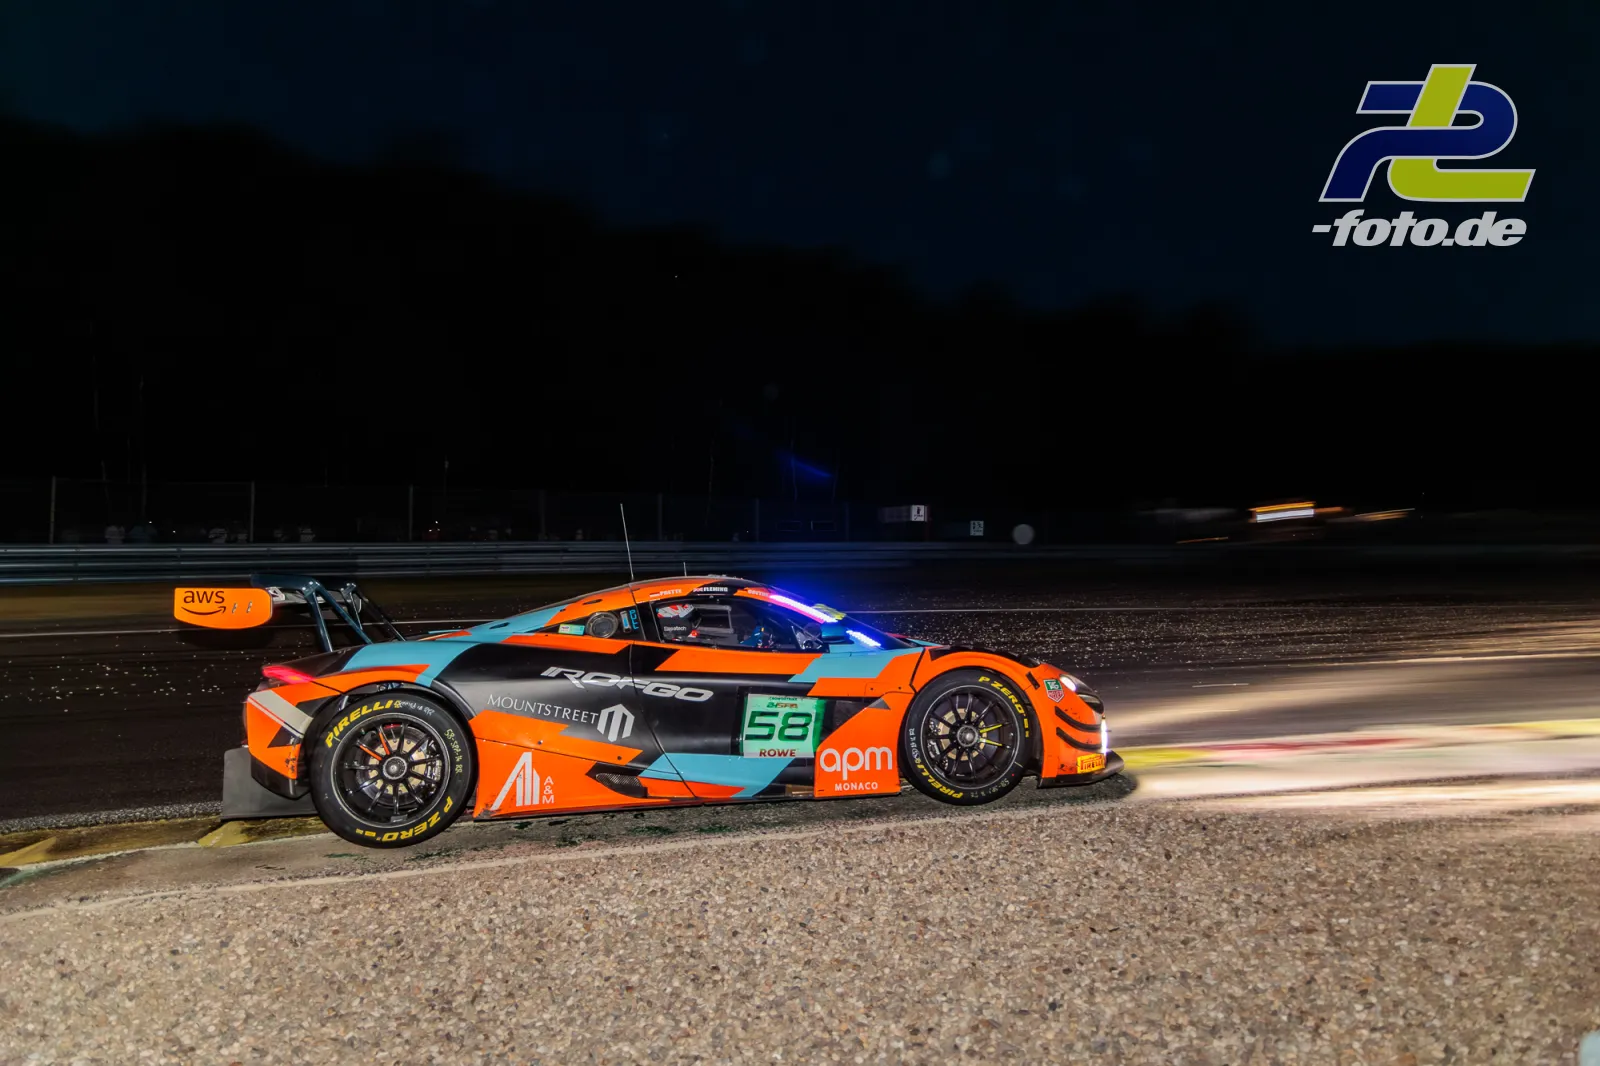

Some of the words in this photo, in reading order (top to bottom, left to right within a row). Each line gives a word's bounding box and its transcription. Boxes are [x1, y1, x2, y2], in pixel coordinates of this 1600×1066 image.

[183, 590, 225, 604] aws
[541, 666, 714, 702] ROFGO
[991, 681, 1025, 714] ZERO
[325, 699, 393, 749] PIRELLI
[487, 694, 599, 725] MOUNTSTREET
[744, 711, 812, 742] 58
[759, 748, 797, 757] ROWE
[819, 746, 893, 780] apm
[834, 781, 879, 791] MONACO
[917, 764, 964, 799] PIRELLI
[443, 795, 454, 814] P
[381, 811, 441, 842] ZERO
